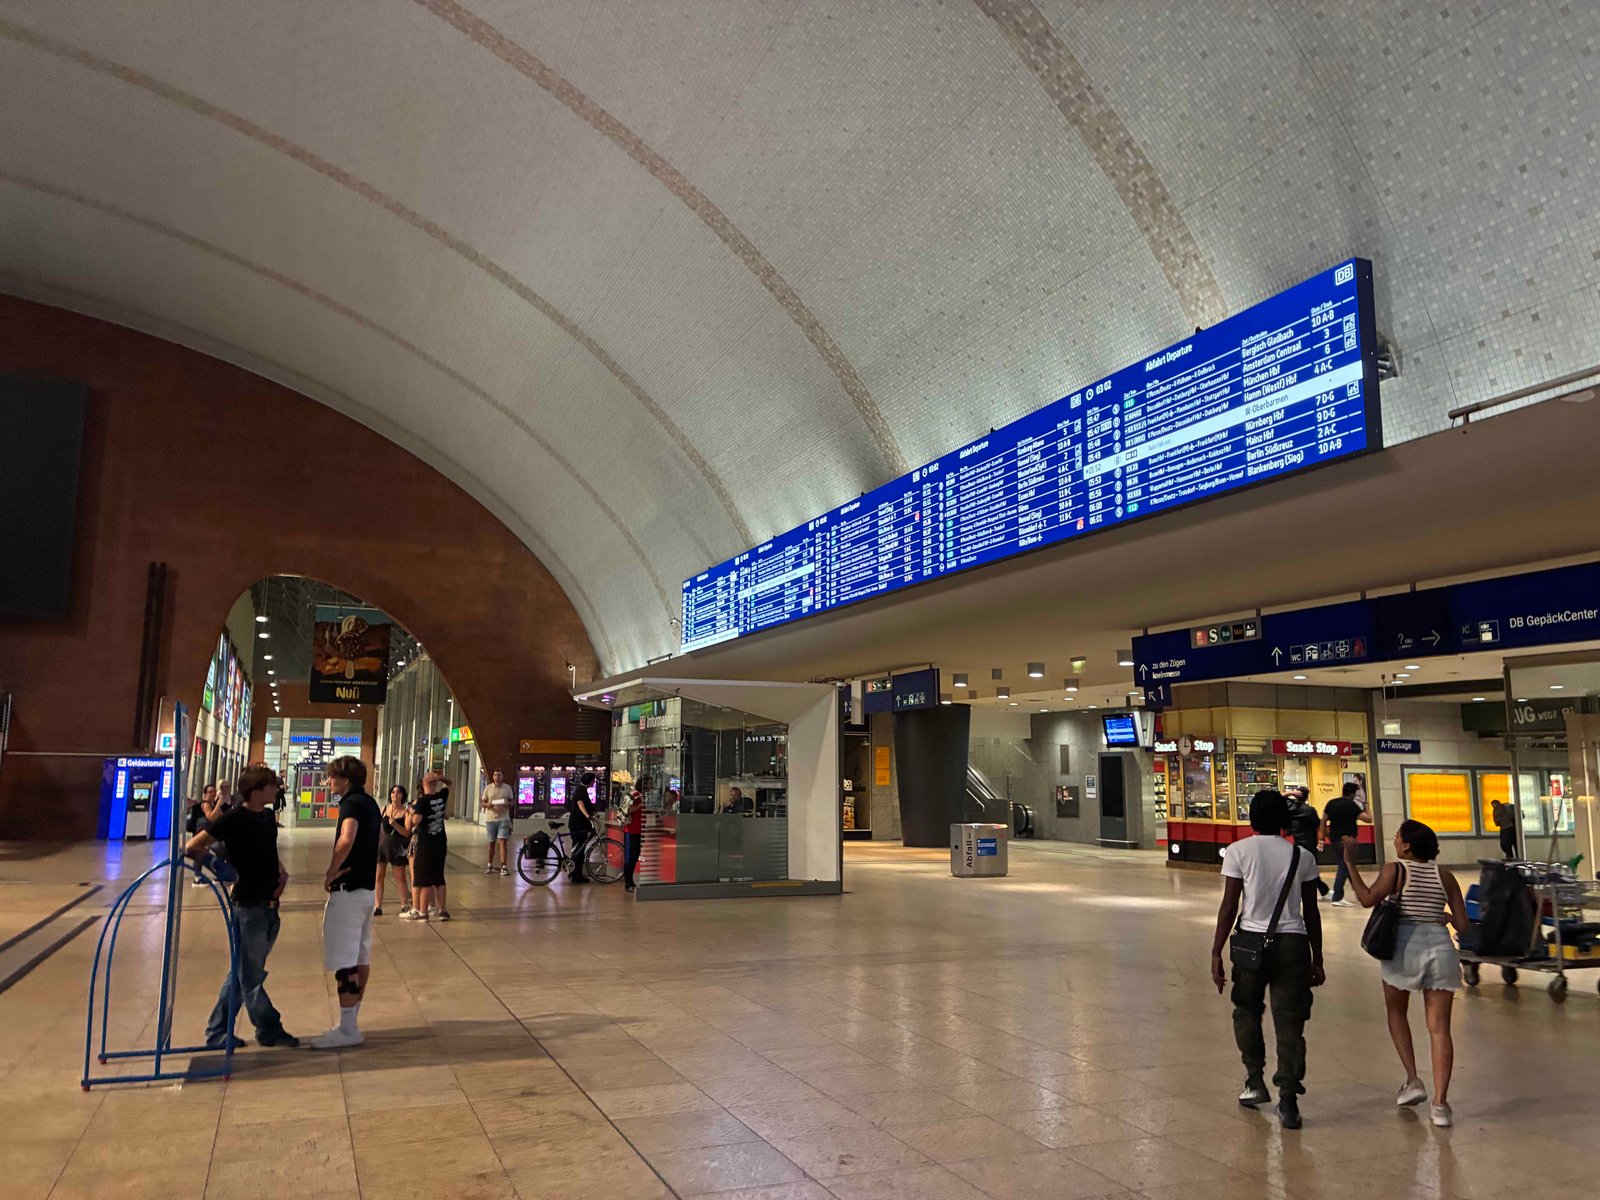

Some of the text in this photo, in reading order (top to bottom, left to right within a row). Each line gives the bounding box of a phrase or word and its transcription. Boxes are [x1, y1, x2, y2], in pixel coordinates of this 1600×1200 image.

[1336, 264, 1352, 283] DB
[1311, 315, 1320, 327] 10
[1324, 328, 1329, 339] 3
[1242, 328, 1293, 358] Bergisch Gladbach
[1324, 344, 1330, 354] 6
[1166, 344, 1192, 362] Departure
[1243, 340, 1301, 373] Amsterdam Centraal
[1243, 364, 1280, 387] München Hbf
[1314, 364, 1319, 374] 4
[1244, 373, 1297, 402] Hamm (Westf) Hbf
[1245, 392, 1288, 416] W-Oberbarmen
[1316, 395, 1320, 406] 7
[1245, 409, 1284, 431] Nürnberg Hbf
[1316, 412, 1322, 422] 9
[1246, 428, 1274, 446] Mainz Hbf
[1317, 428, 1323, 438] 2
[1246, 440, 1293, 461] Berlin Südkreuz
[1318, 442, 1328, 454] 10
[1247, 450, 1303, 476] Blankenberg (Sieg)
[1509, 608, 1598, 629] DB GepäckCenter
[1208, 628, 1218, 643] S
[1159, 660, 1169, 668] den
[1169, 658, 1186, 668] Zügen
[1291, 653, 1301, 662] WC
[1154, 740, 1214, 753] Snack Stop
[1286, 741, 1338, 755] Snack Stop
[1381, 740, 1412, 750] A-Passage
[127, 759, 164, 768] Geldautomat
